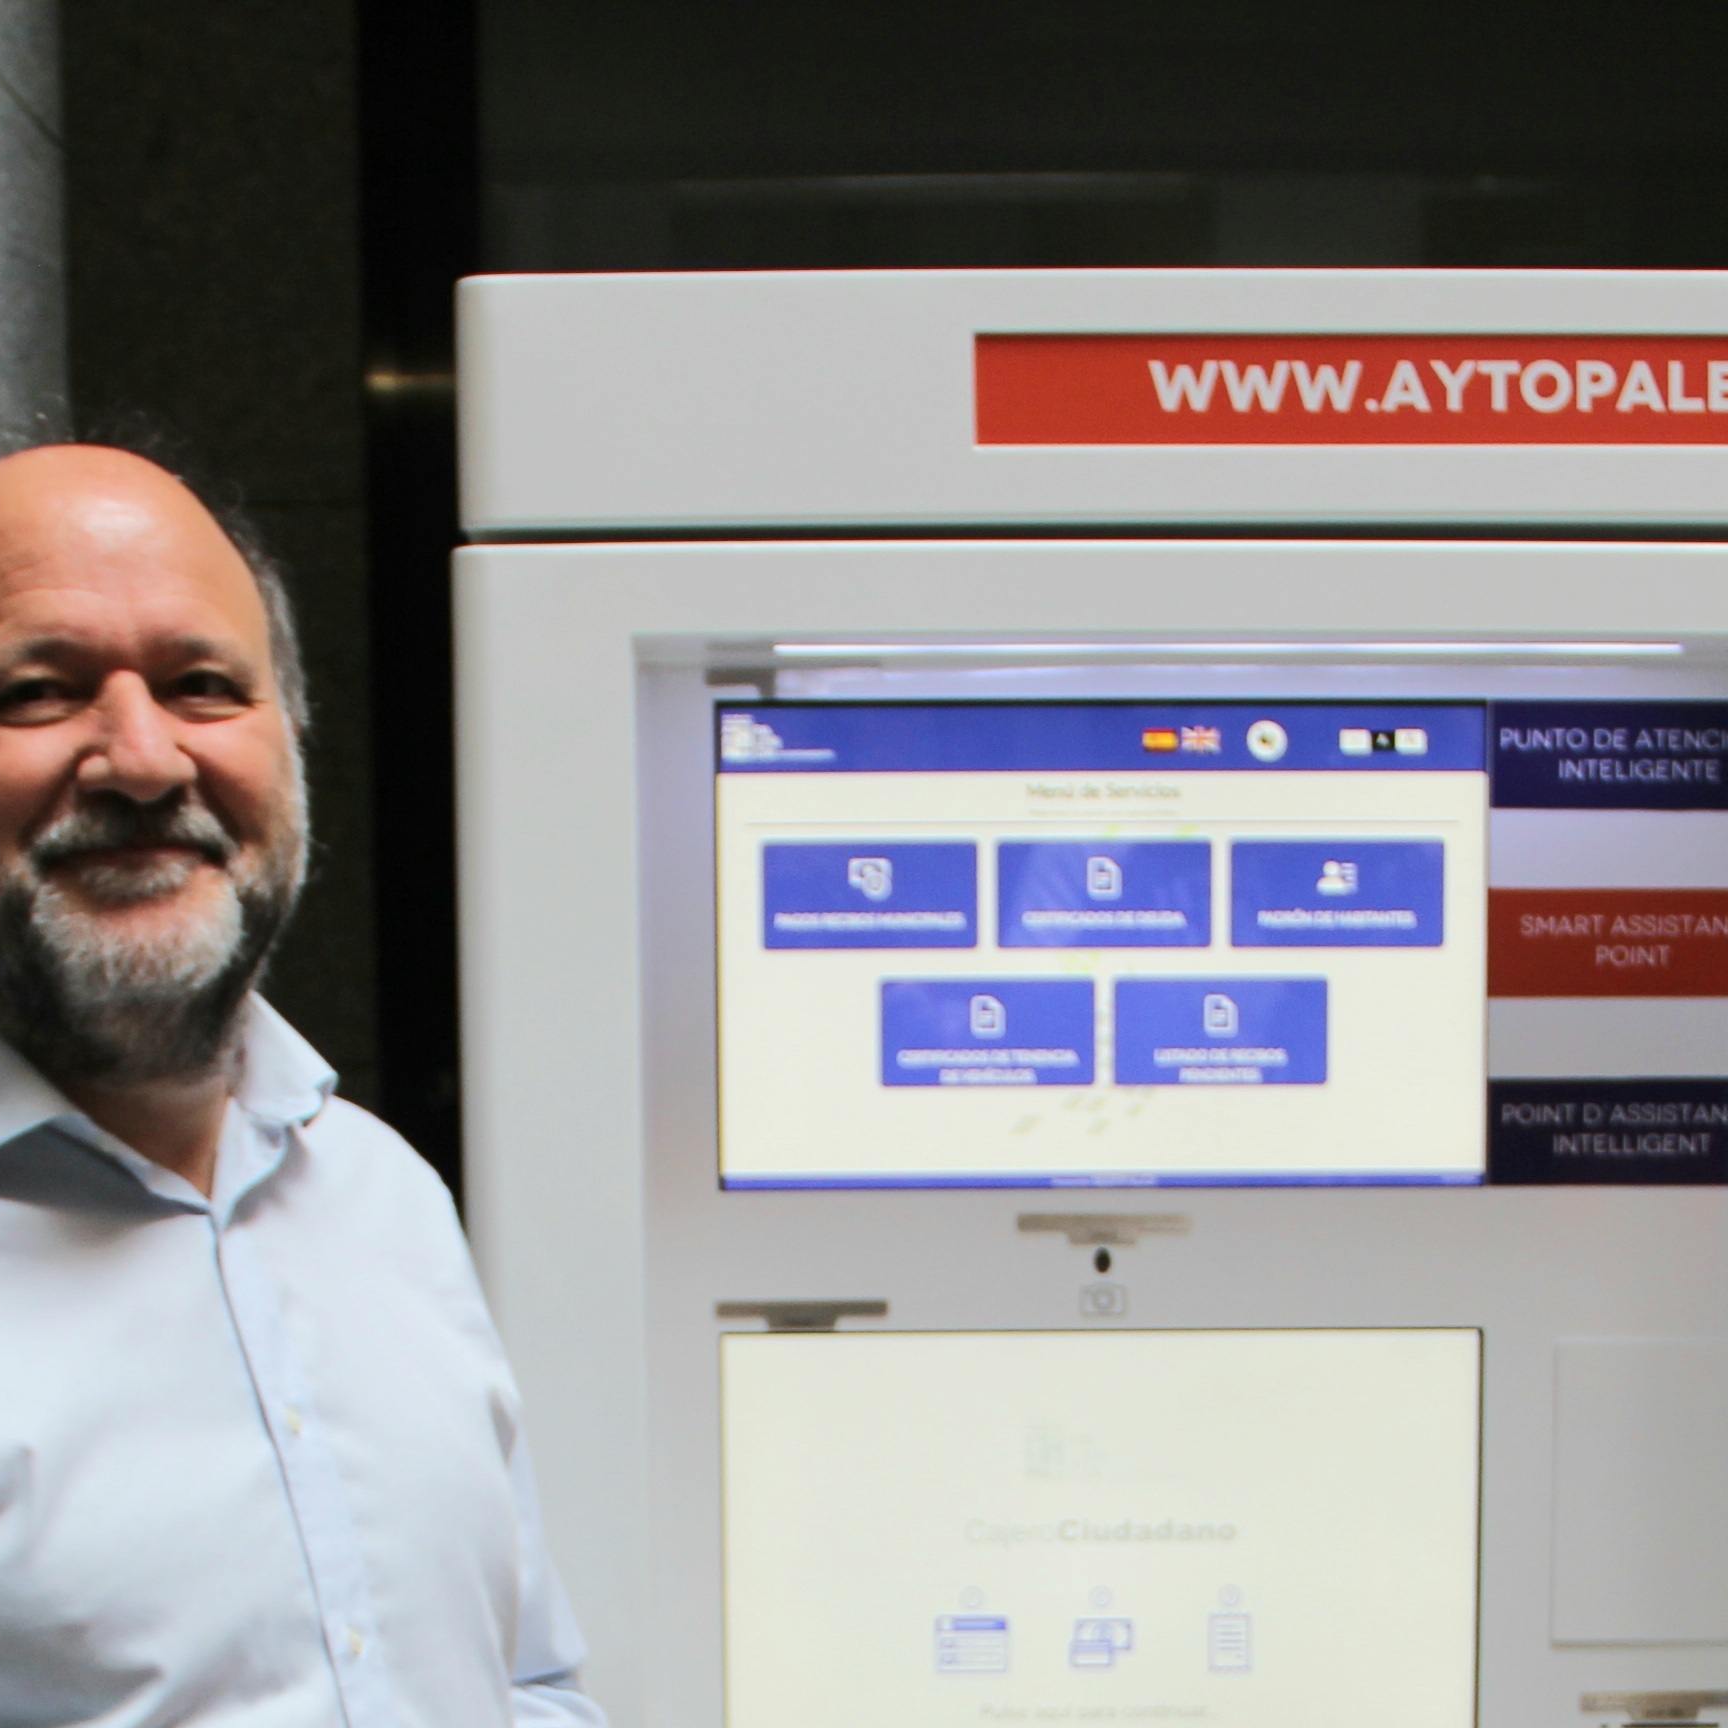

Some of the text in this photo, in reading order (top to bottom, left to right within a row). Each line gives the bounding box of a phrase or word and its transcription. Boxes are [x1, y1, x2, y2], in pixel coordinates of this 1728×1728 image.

[1499, 727, 1588, 749] PUNTO
[1593, 727, 1628, 749] DE
[1558, 759, 1720, 781] INTELIGENTE
[1520, 915, 1605, 937] SMART
[1595, 944, 1671, 967] POINT
[1501, 1103, 1574, 1125] POINT
[1553, 1133, 1712, 1156] INTELLIGENT
